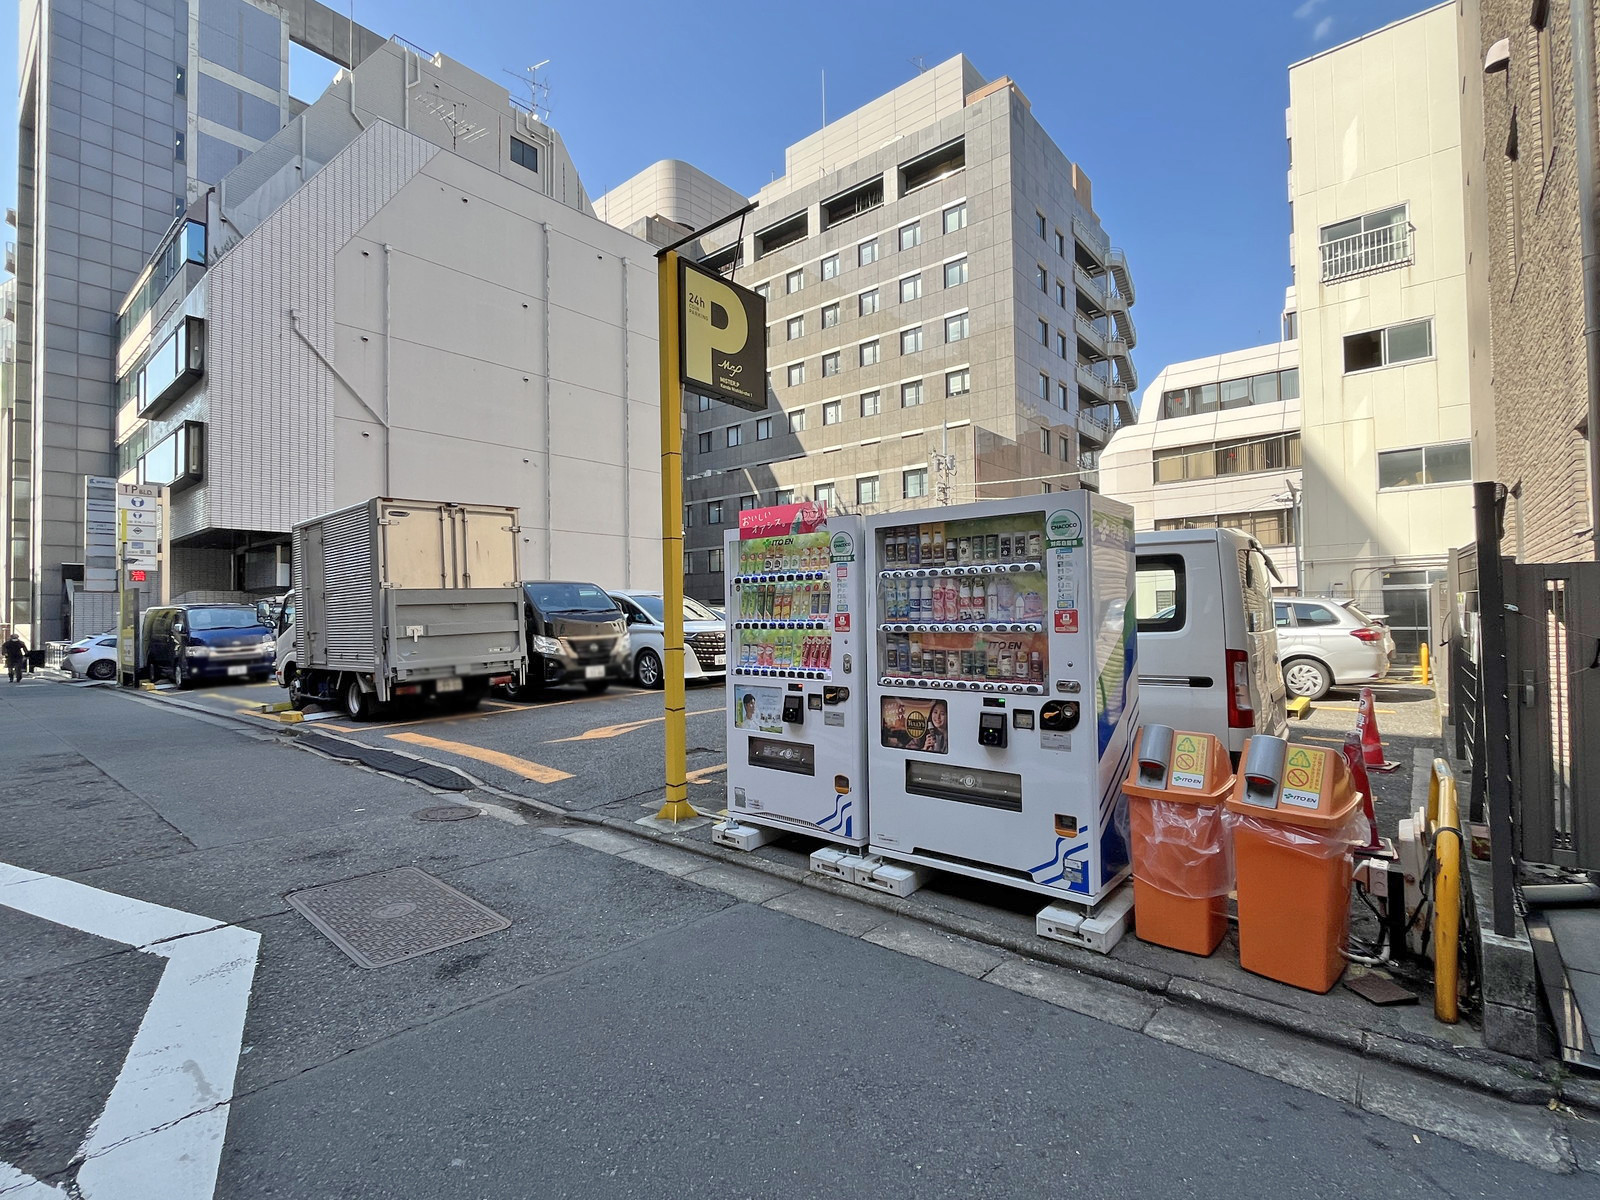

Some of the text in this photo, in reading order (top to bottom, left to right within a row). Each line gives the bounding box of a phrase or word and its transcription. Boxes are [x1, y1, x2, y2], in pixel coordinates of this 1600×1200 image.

[688, 292, 705, 309] 24h
[688, 308, 709, 321] PARKING
[685, 266, 748, 385] P
[742, 511, 771, 527] おいしい
[1050, 522, 1078, 531] CHACOCO
[771, 537, 794, 547] ITO EN
[987, 641, 1022, 650] ITO EN
